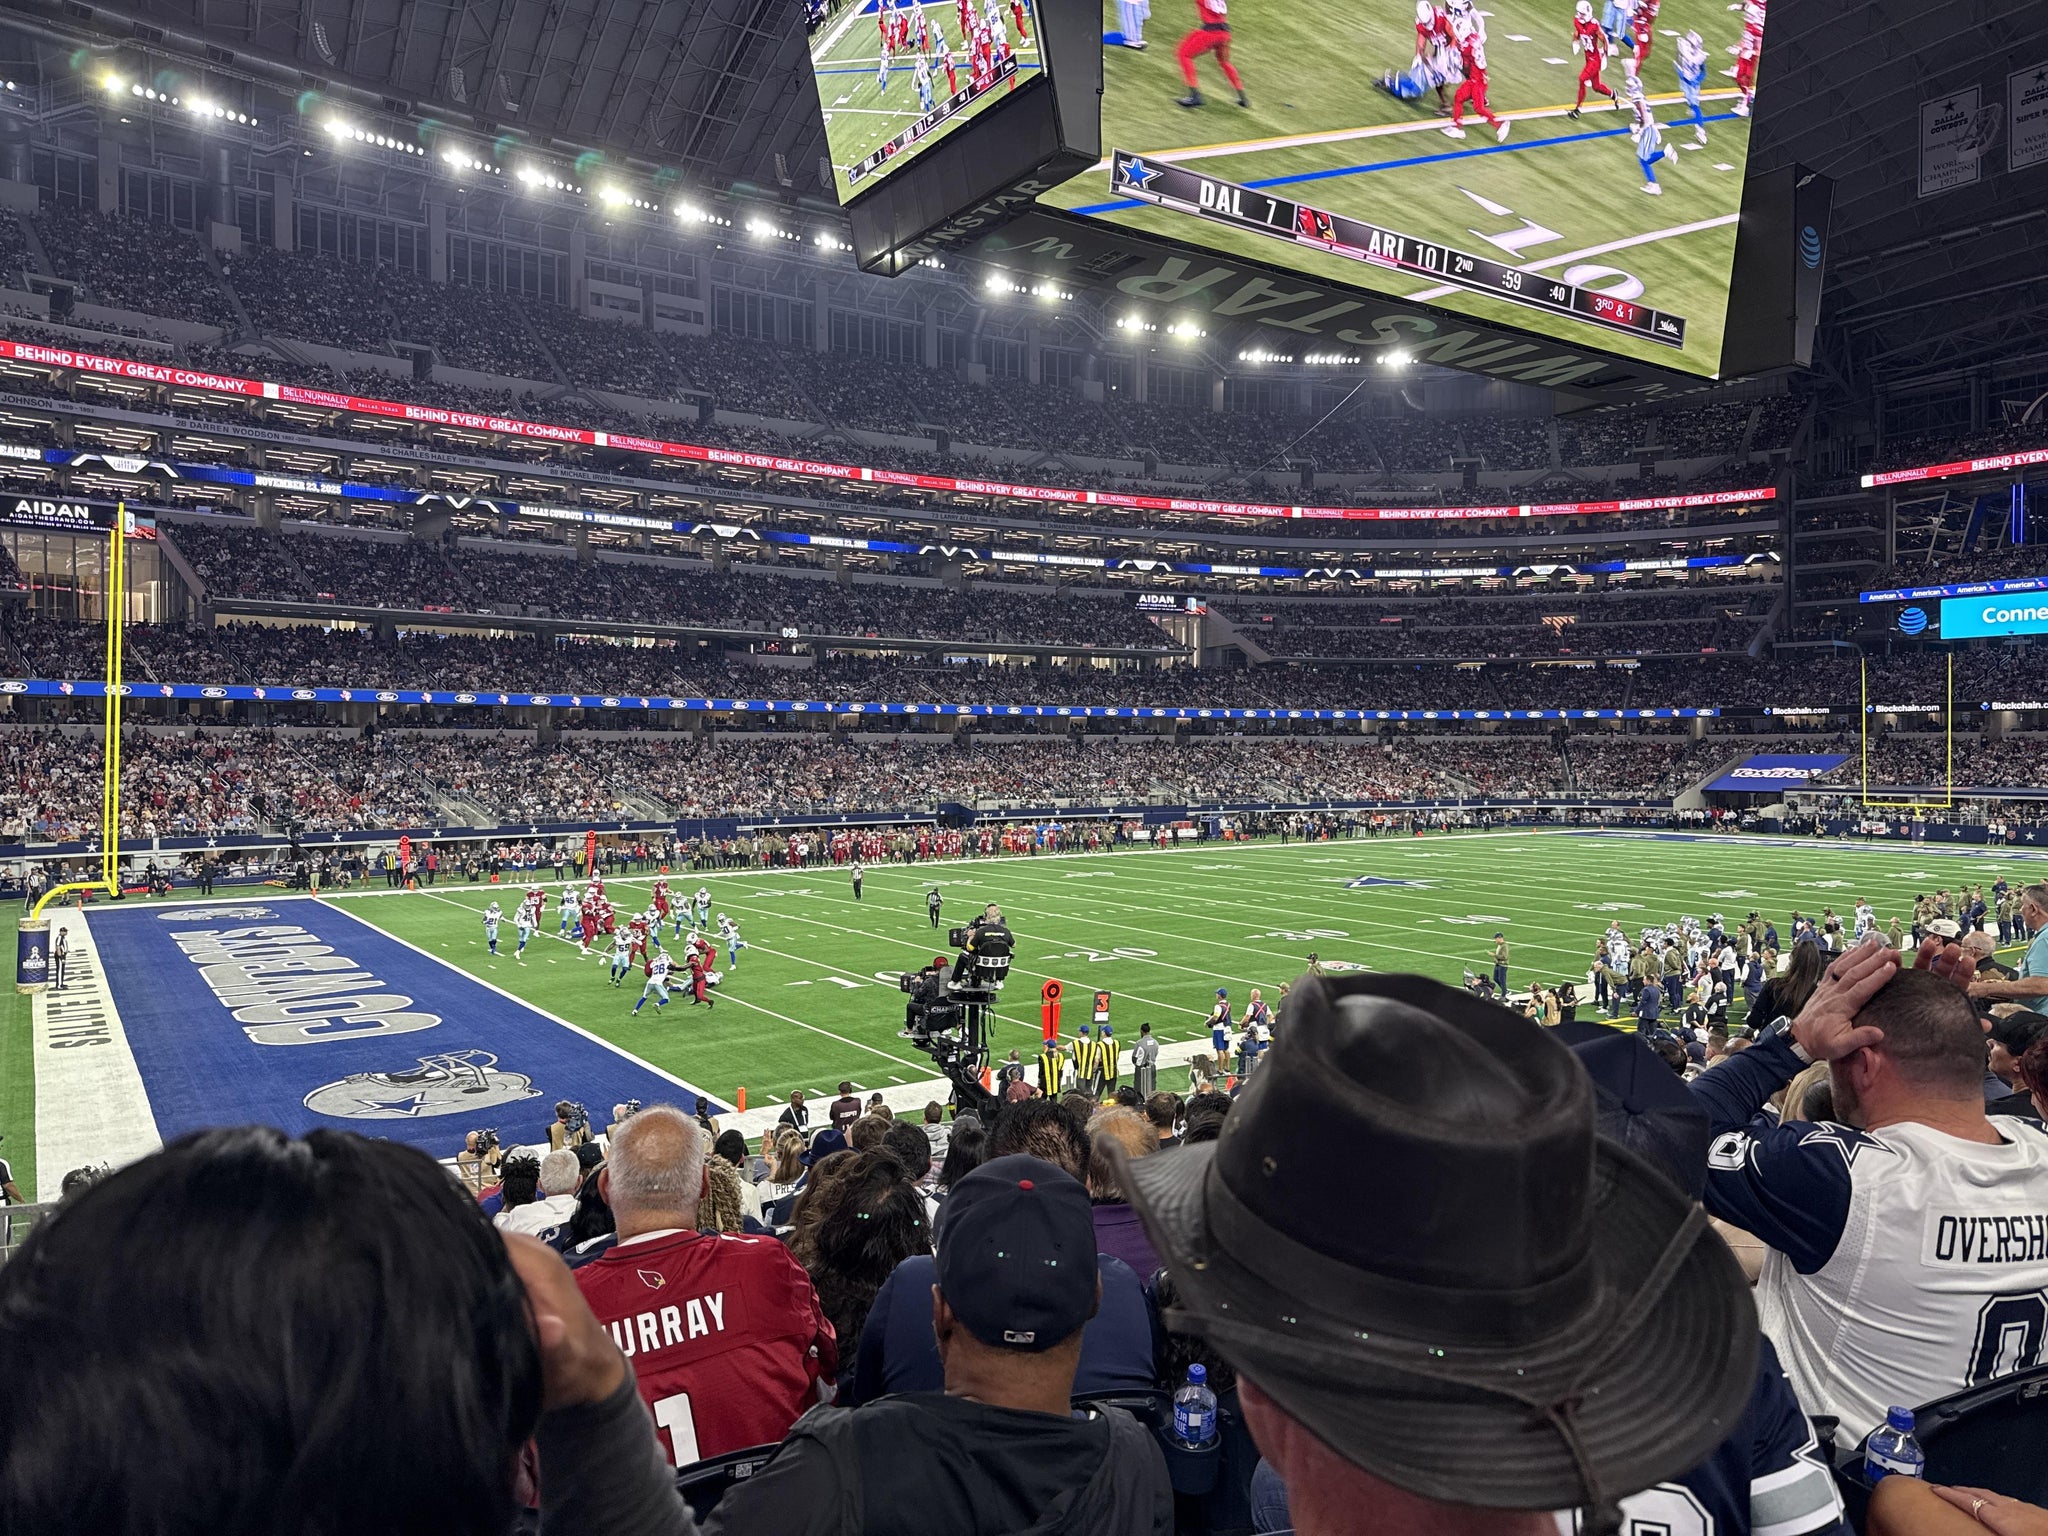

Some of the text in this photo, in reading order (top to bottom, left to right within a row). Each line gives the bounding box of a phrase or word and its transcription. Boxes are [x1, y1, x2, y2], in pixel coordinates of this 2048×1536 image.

[1930, 118, 1969, 135] COWBOYS
[1934, 111, 1965, 127] DALLAS
[1923, 162, 1976, 183] CHAMPIONS
[1201, 180, 1277, 225] DAL 7
[903, 179, 1050, 259] WINSTAR
[1368, 230, 1438, 272] ARI 10
[1455, 256, 1474, 274] 2ND
[1501, 271, 1522, 292] :59
[1549, 284, 1566, 302] :40
[1595, 297, 1634, 322] 3RD & 1
[1116, 257, 1608, 387] WINSTAR
[15, 345, 246, 393] BEHIND EVERY GREAT COMPANY.
[0, 394, 53, 409] JOHNSON
[189, 421, 229, 433] DARREN
[232, 427, 280, 440] WOODSON
[405, 407, 582, 441] BEHIND EVERY GREAT COMPANY.
[380, 447, 457, 463] 94 CHARLES HALEY
[708, 450, 850, 478] BEHIND EVERY GREAT COMPANY.
[1972, 457, 2012, 471] BEHIND
[2015, 452, 2048, 465] EVERY
[560, 469, 590, 480] MICHAEL
[592, 474, 611, 482] IRVIN
[255, 475, 342, 495] NOVEMBER 23, 2025
[700, 487, 717, 495] TROY
[717, 490, 741, 498] AIKMAN
[955, 481, 985, 493] BEHIND
[986, 484, 1010, 495] EVERY
[1012, 486, 1037, 497] GREAT
[1038, 488, 1078, 501] COMPANY.
[15, 499, 89, 519] AIDAN
[1171, 501, 1197, 511] BEHIND
[1199, 503, 1221, 512] EVERY
[1222, 504, 1245, 514] GREAT
[1246, 505, 1284, 516] COMPANY.
[1619, 500, 1652, 511] BEHIND
[1654, 497, 1683, 508] EVERY
[1685, 495, 1714, 506] GREAT
[1716, 490, 1765, 503] COMPANY.
[519, 505, 548, 517] DALLAS
[549, 508, 583, 521] COWBOYS
[594, 513, 646, 527] PHILADELPHIA
[646, 518, 673, 530] EAGLES
[1379, 509, 1409, 519] BEHIND
[1410, 509, 1436, 519] EVERY
[1437, 509, 1464, 519] GREAT
[1465, 508, 1509, 518] COMPANY.
[1912, 588, 1940, 597] American
[1956, 585, 1987, 594] American
[2004, 581, 2035, 590] American
[1139, 594, 1175, 604] AIDAN
[1869, 592, 1896, 601] American
[1772, 706, 1830, 715] Blockchain.com
[1875, 704, 1940, 713] Blockchain.com
[1265, 929, 1350, 941] 30
[1063, 948, 1158, 962] 20
[22, 960, 46, 969] SERVICE
[169, 926, 443, 1046] COWBOYS
[1096, 994, 1109, 1012] 3
[46, 999, 112, 1049] SALUTE
[840, 1110, 858, 1118] ESPN
[1936, 1215, 2048, 1263] OVERSH
[602, 1291, 724, 1359] URRAY
[653, 1392, 700, 1468] 1
